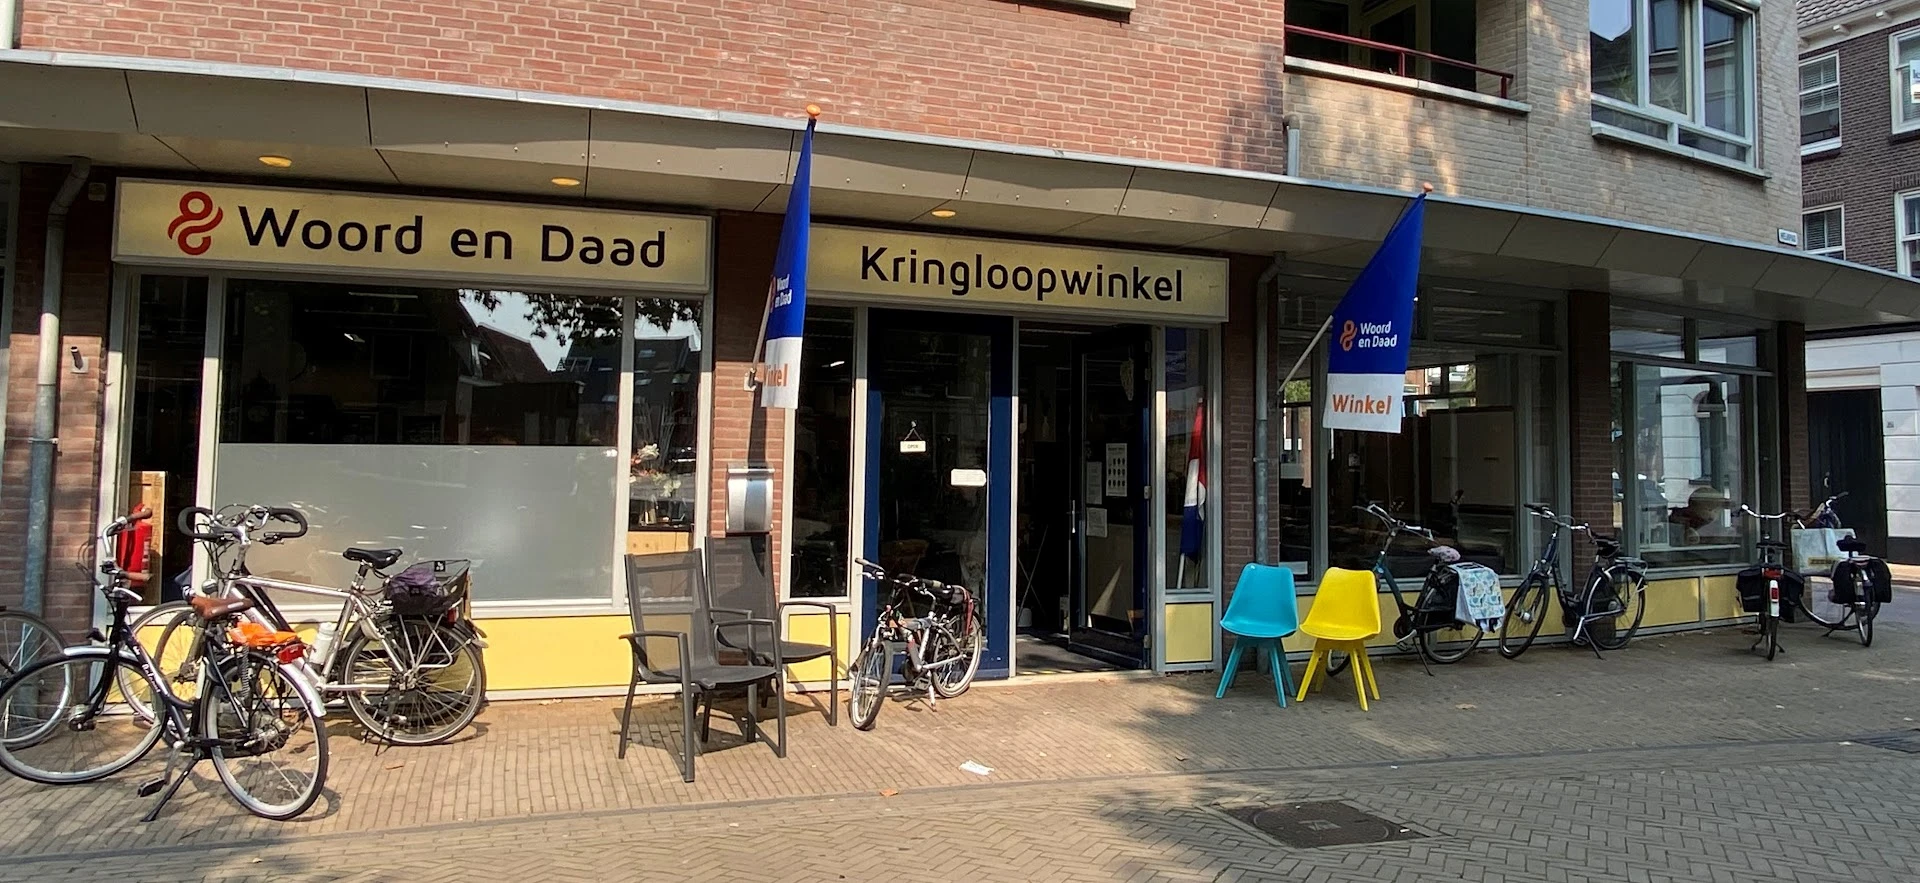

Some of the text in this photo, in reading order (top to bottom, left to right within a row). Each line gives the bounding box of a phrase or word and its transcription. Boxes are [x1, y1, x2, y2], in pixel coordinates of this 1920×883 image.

[238, 205, 666, 268] Woord en Daad
[861, 245, 1183, 302] Kringloopwinkel
[1360, 321, 1391, 334] Woord
[1358, 334, 1397, 347] en Daad
[1332, 394, 1391, 414] Winkel
